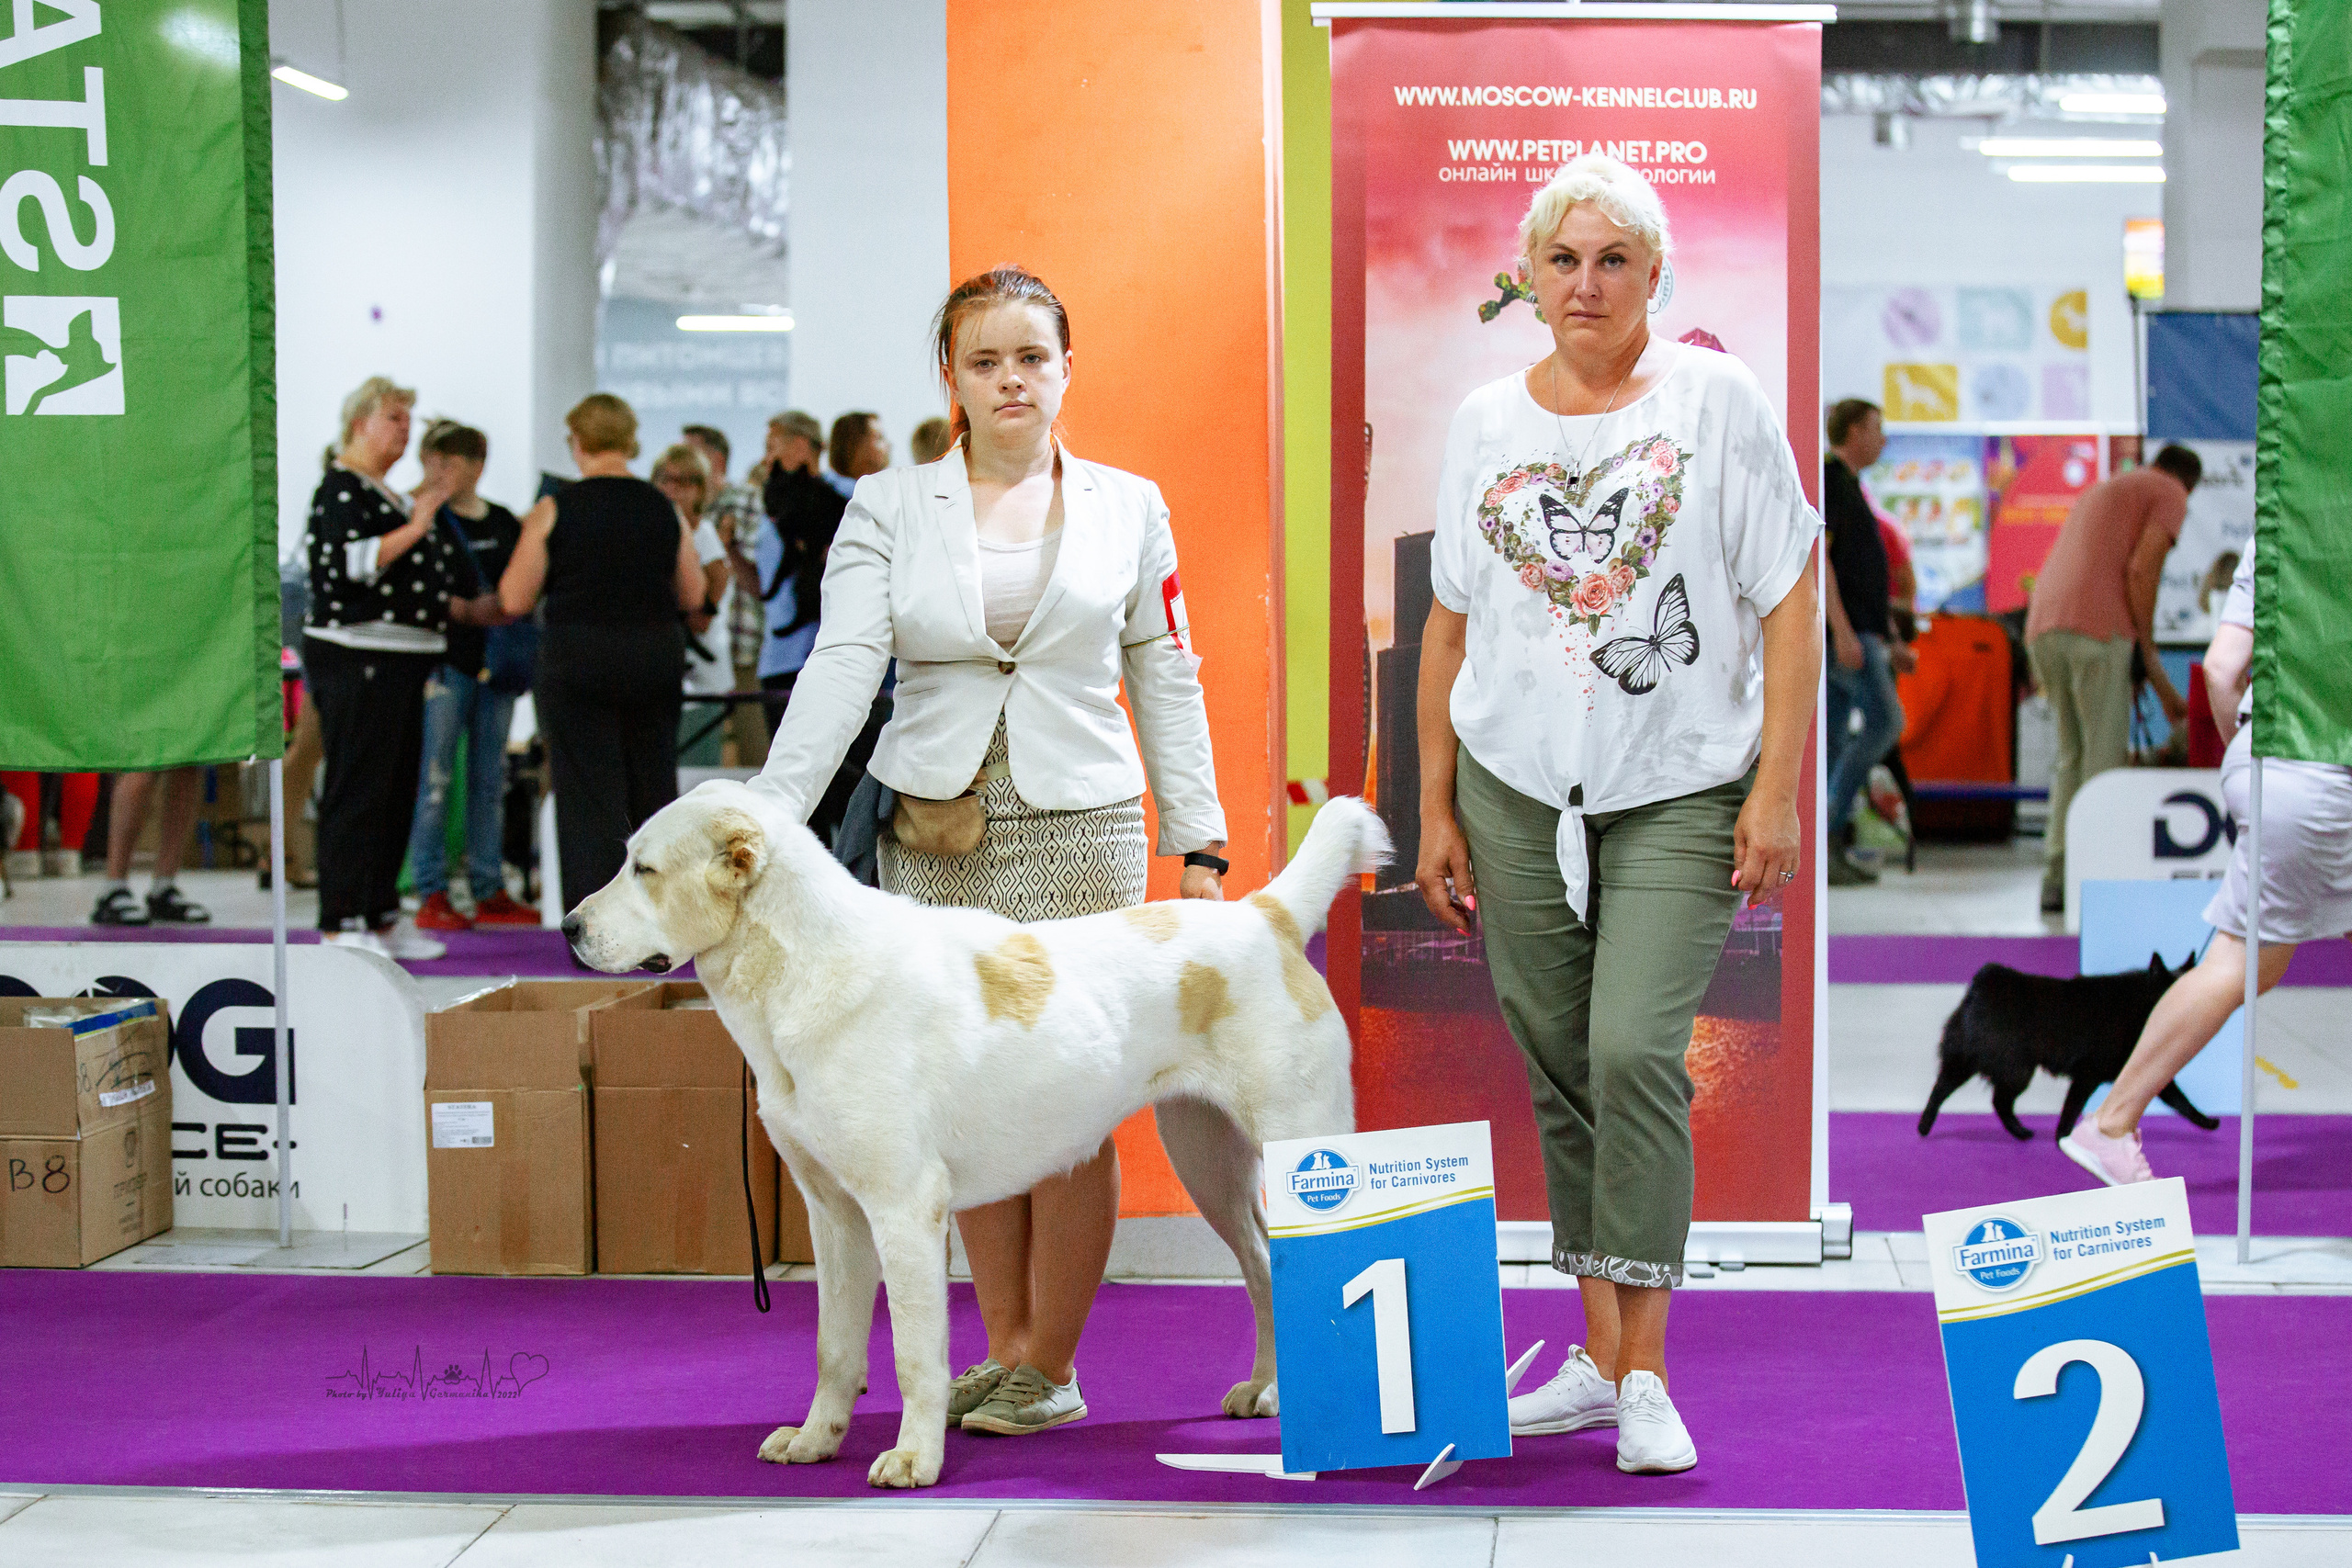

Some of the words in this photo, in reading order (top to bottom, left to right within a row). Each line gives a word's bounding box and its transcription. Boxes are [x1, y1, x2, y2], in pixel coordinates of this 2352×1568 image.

[1393, 85, 1758, 109] WWW.MOSCOW-KENNELCLUB.RU
[1439, 162, 1516, 182] онлайн
[1526, 166, 1555, 182] шк
[1639, 167, 1716, 185] ологии
[1369, 1160, 1421, 1175] Nutrition
[1425, 1155, 1469, 1171] System
[1291, 1171, 1355, 1190] Farmina
[1370, 1178, 1387, 1190] for
[1391, 1171, 1456, 1188] Carnivores
[1306, 1195, 1318, 1203] Pet
[1320, 1193, 1341, 1201] Foods
[2049, 1224, 2111, 1245] Nutrition
[2115, 1215, 2165, 1238] System
[1960, 1243, 2035, 1267] Farmina
[2052, 1247, 2073, 1261] for
[2077, 1235, 2153, 1257] Carnivores
[1980, 1270, 1995, 1280] Pet
[1996, 1267, 2021, 1278] Foods
[1342, 1258, 1416, 1434] 1
[2013, 1339, 2165, 1546] 2
